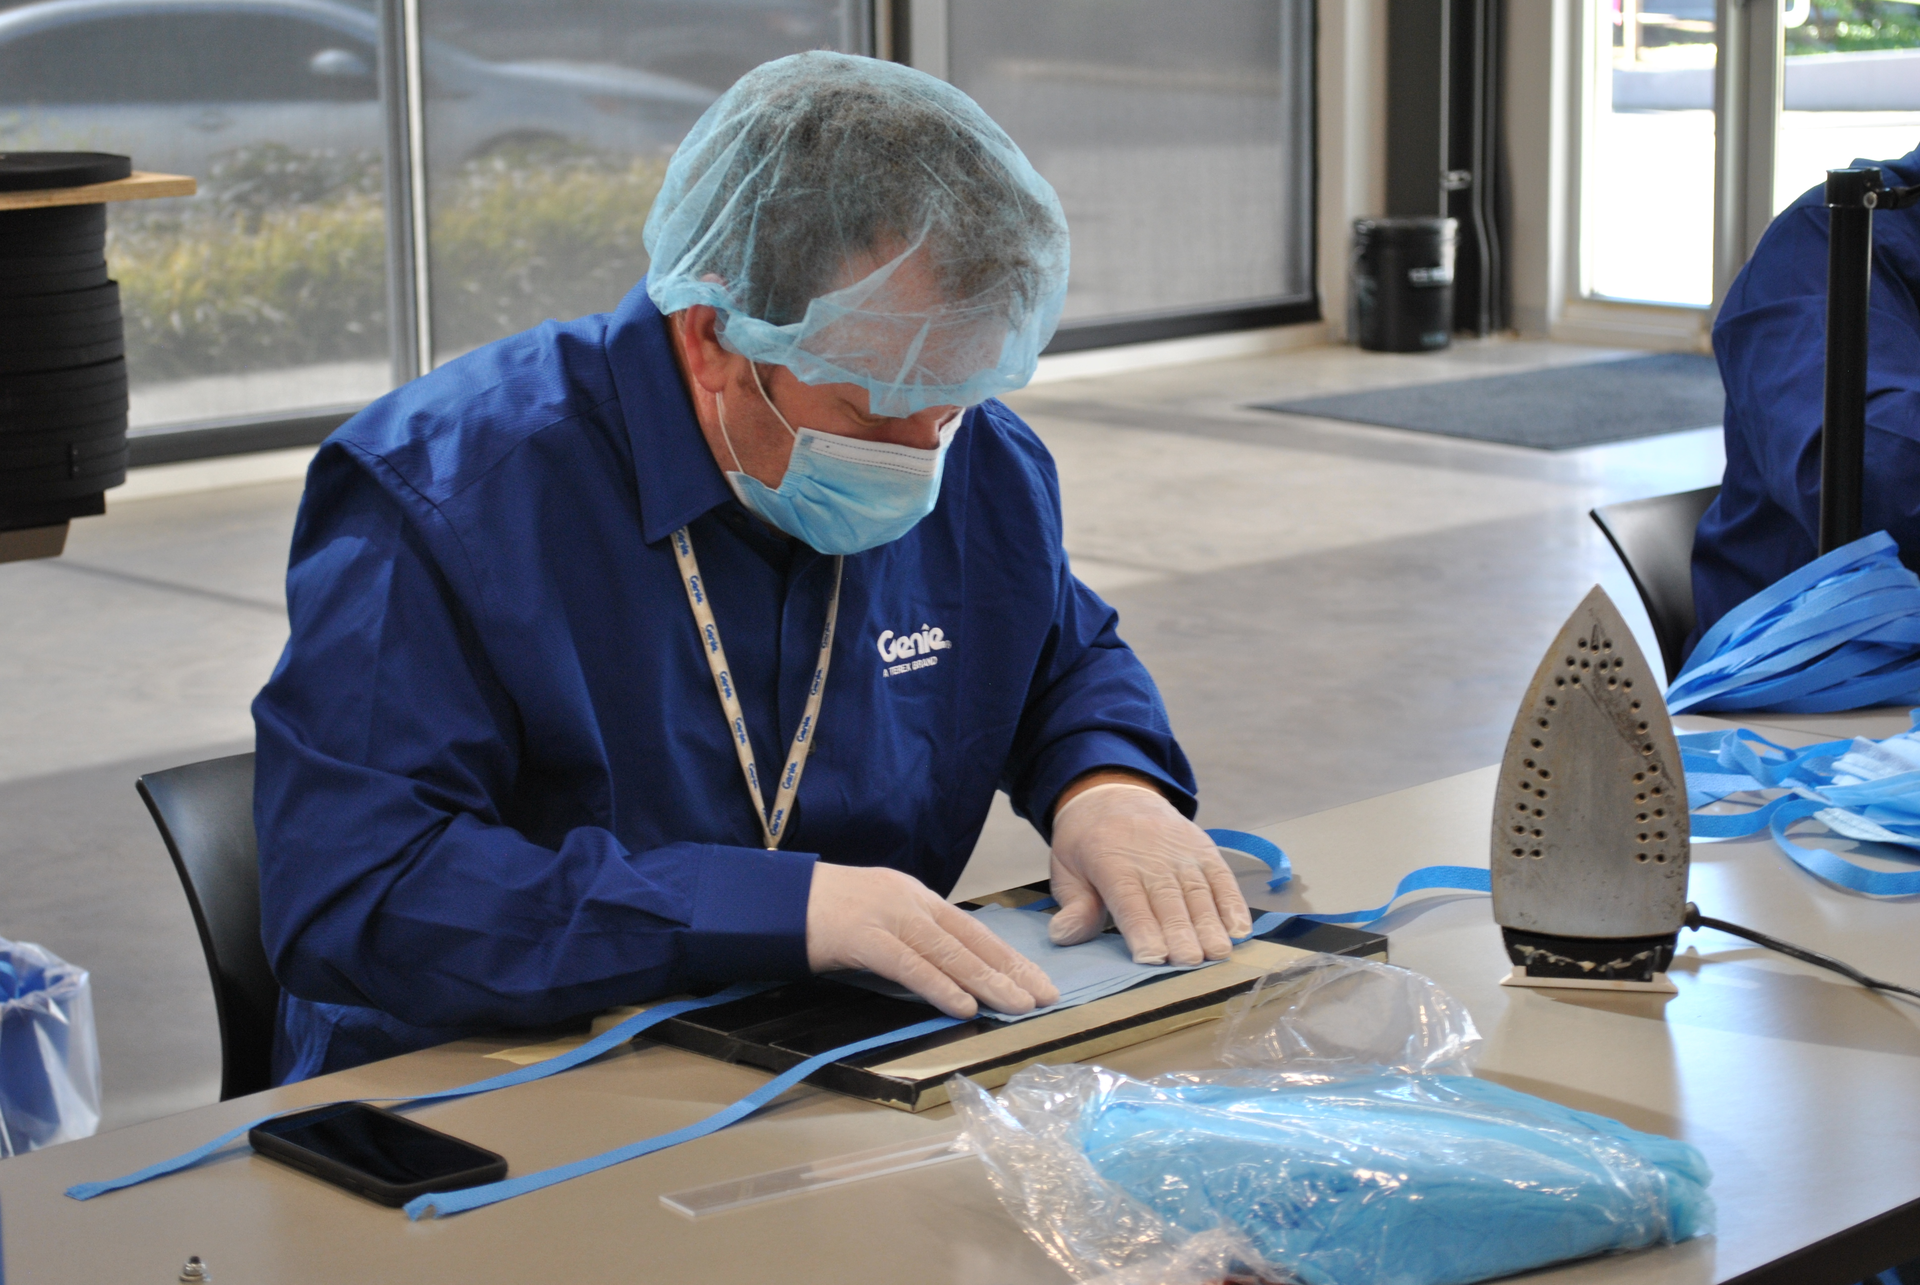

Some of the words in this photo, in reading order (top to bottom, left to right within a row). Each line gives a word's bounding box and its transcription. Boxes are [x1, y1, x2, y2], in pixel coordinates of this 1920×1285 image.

[877, 623, 947, 663] Genie
[882, 668, 889, 678] A
[782, 762, 797, 789] Genie
